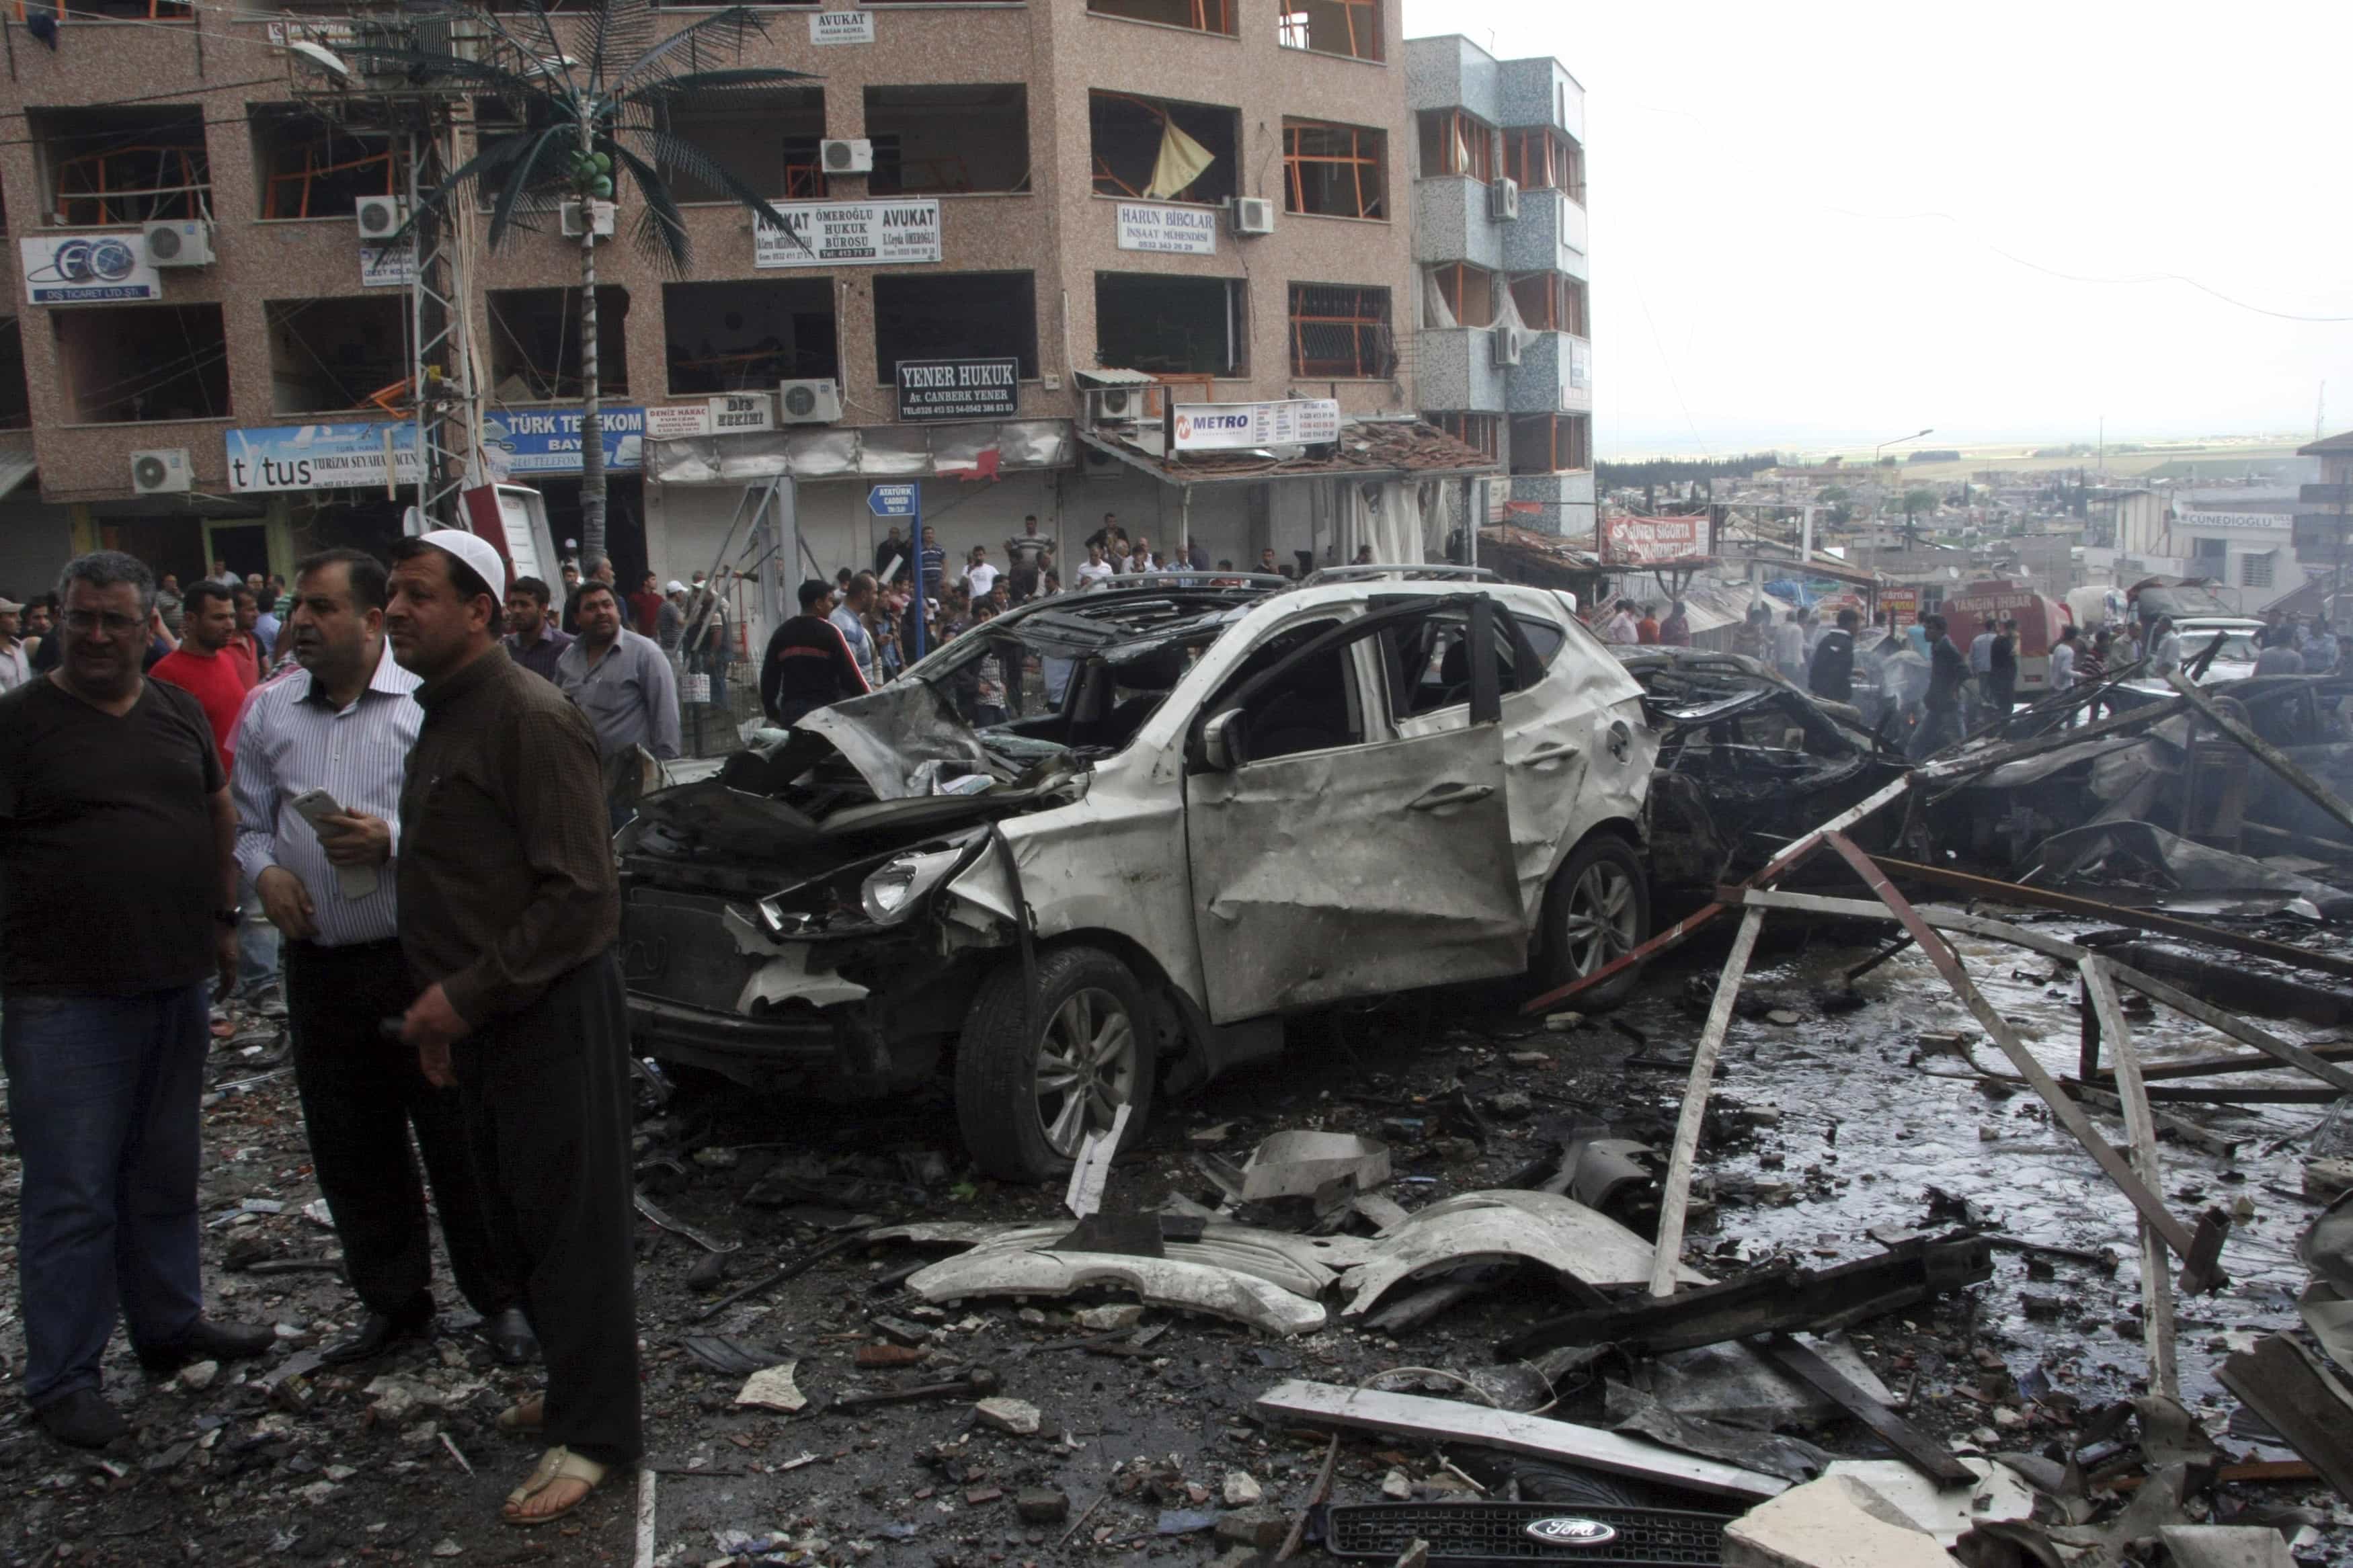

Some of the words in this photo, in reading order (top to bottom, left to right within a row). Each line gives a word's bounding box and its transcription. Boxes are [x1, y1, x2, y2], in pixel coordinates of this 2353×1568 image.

[819, 13, 865, 26] AVUKAT
[816, 207, 873, 222] ÖMEROĞLU
[883, 208, 935, 227] AVUKAT
[1122, 208, 1160, 224] HARUN
[825, 223, 868, 235] HUKUK
[1127, 227, 1158, 240] İNŞAAT
[826, 235, 869, 248] BÜROSU
[902, 366, 955, 388] YENER
[958, 364, 1014, 386] HUKUK
[924, 390, 972, 403] CANBERK
[974, 389, 1008, 401] YENER
[508, 414, 557, 435] TÜRK
[1193, 415, 1248, 430] METRO
[352, 453, 387, 468] SEYAHA
[1546, 1520, 1596, 1536] Ford
